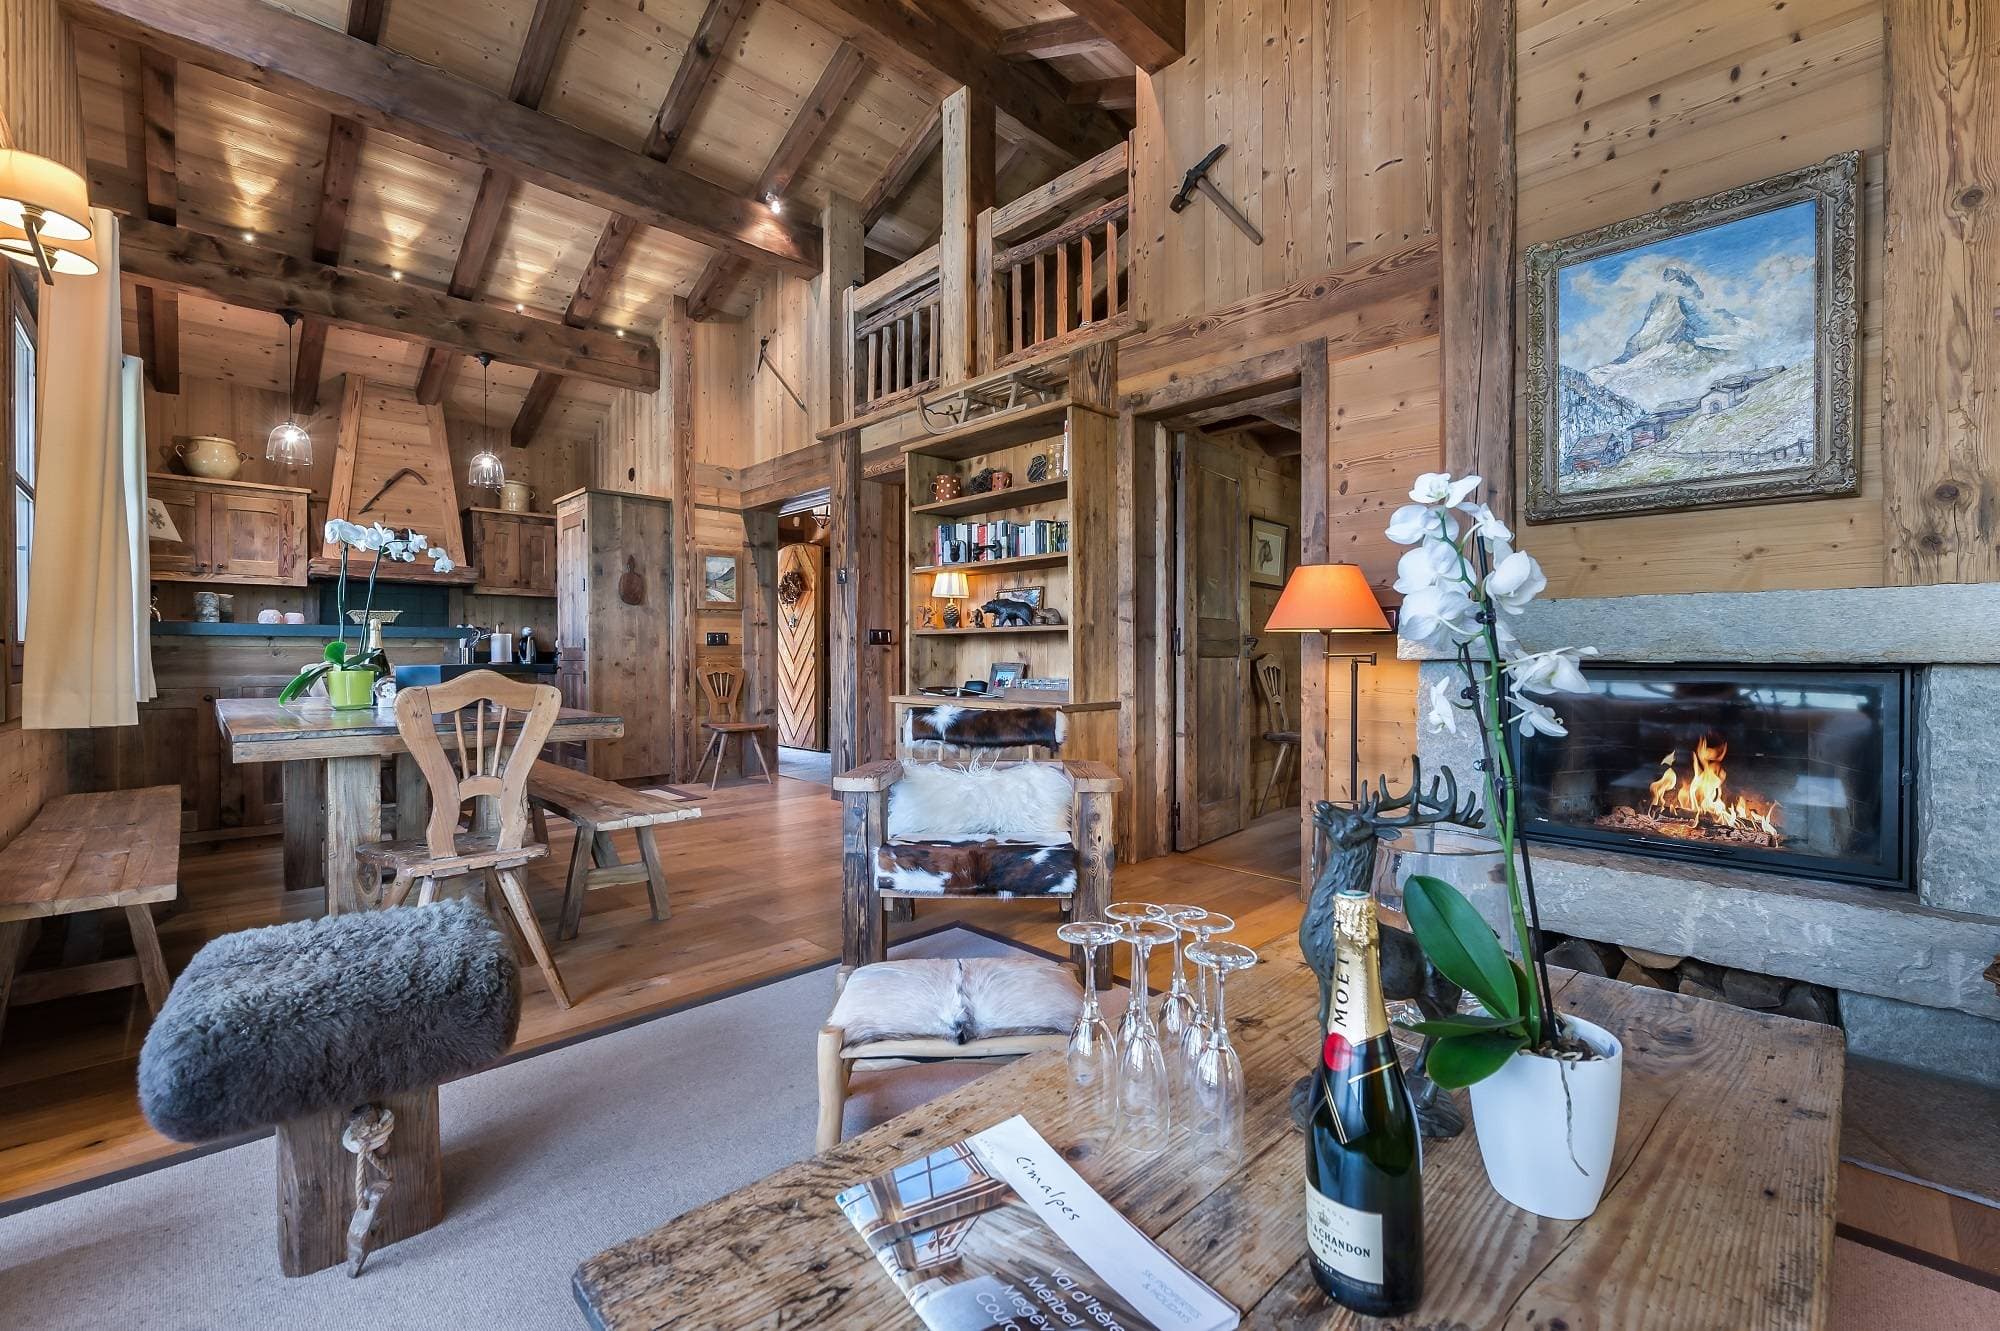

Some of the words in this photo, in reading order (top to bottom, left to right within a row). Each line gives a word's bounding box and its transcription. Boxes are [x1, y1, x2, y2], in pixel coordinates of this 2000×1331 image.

[1016, 1155, 1081, 1222] Cimalpes
[1319, 1228, 1371, 1259] CHANDON
[1023, 1276, 1085, 1327] Méribel
[1051, 1267, 1080, 1291] Val
[1071, 1290, 1125, 1331] d'Isère
